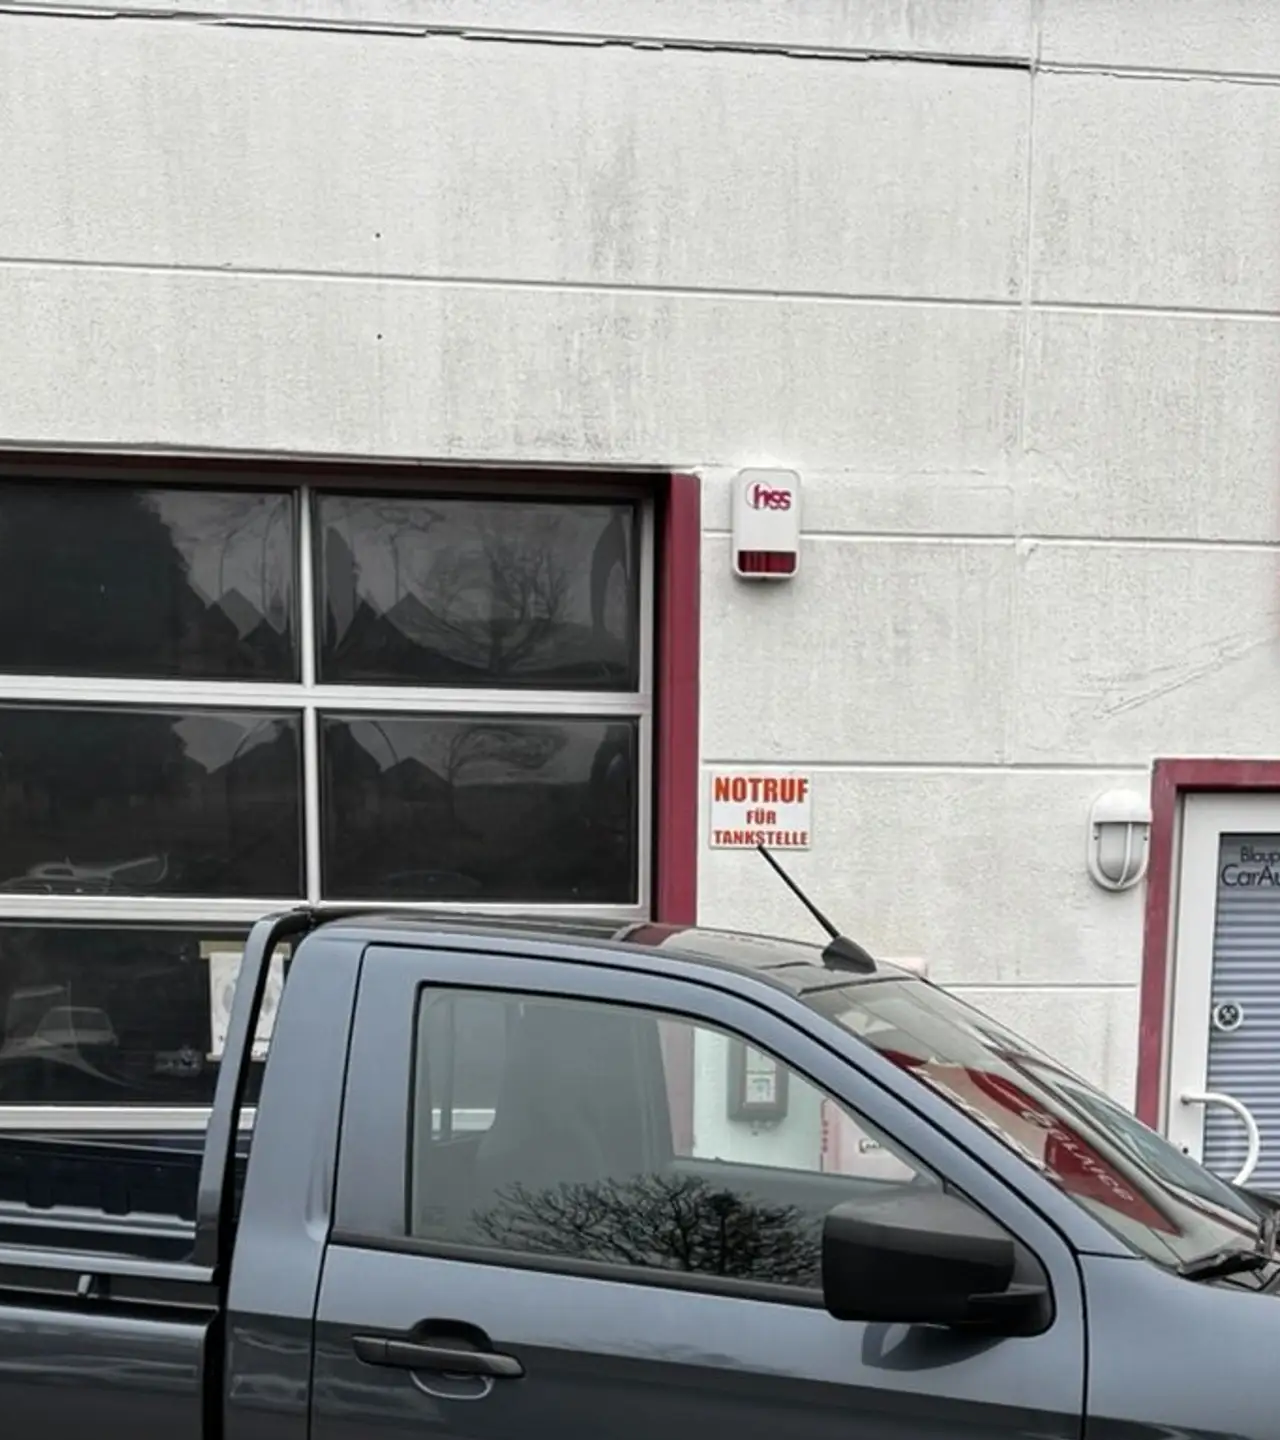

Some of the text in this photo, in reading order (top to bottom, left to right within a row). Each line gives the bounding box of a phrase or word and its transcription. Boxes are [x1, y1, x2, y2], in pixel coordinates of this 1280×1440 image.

[715, 777, 808, 803] NOTRUF
[746, 808, 776, 825] FÜR
[714, 830, 808, 845] TANKSTELLE
